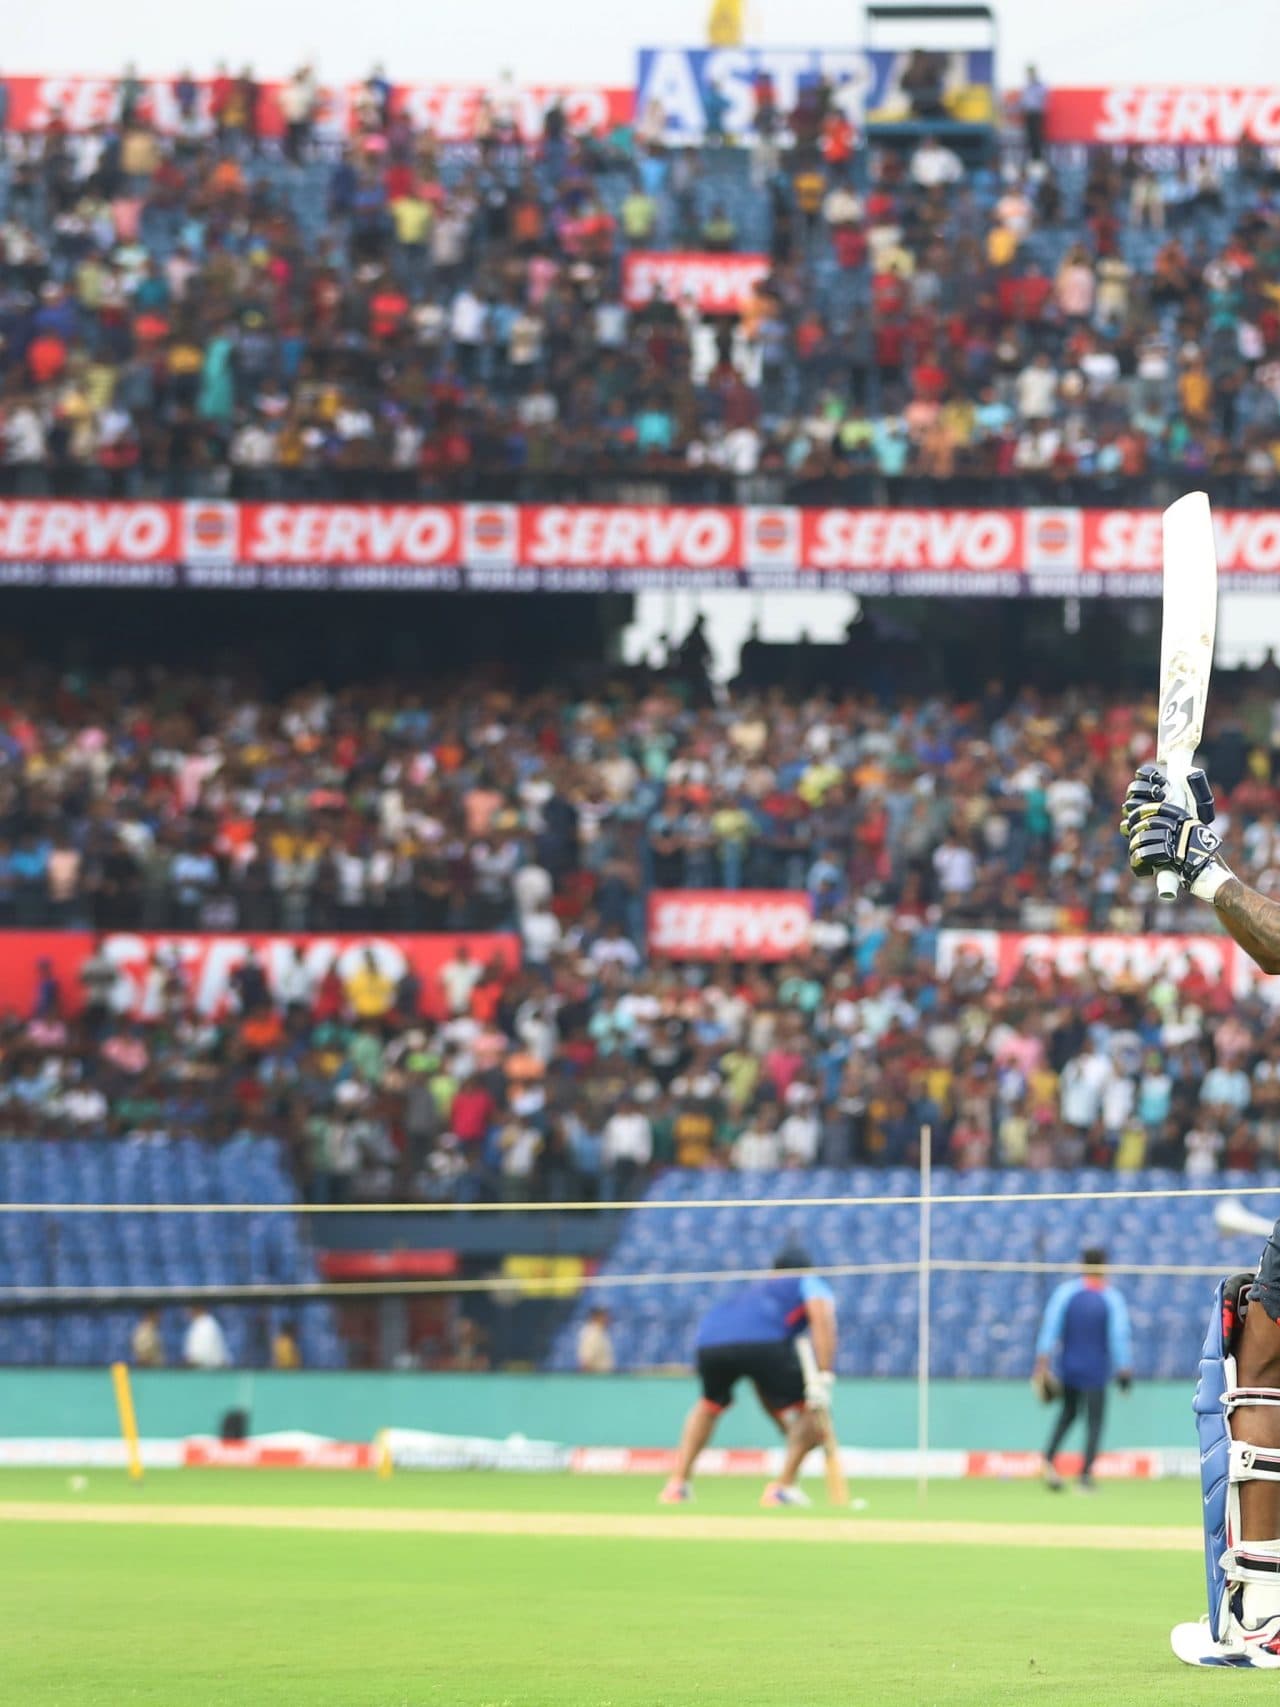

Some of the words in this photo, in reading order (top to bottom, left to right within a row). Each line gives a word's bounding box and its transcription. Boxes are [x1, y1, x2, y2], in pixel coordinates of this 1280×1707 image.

[250, 506, 455, 562] SERVO
[529, 508, 733, 566] SERVO
[809, 510, 1016, 570] SERVO
